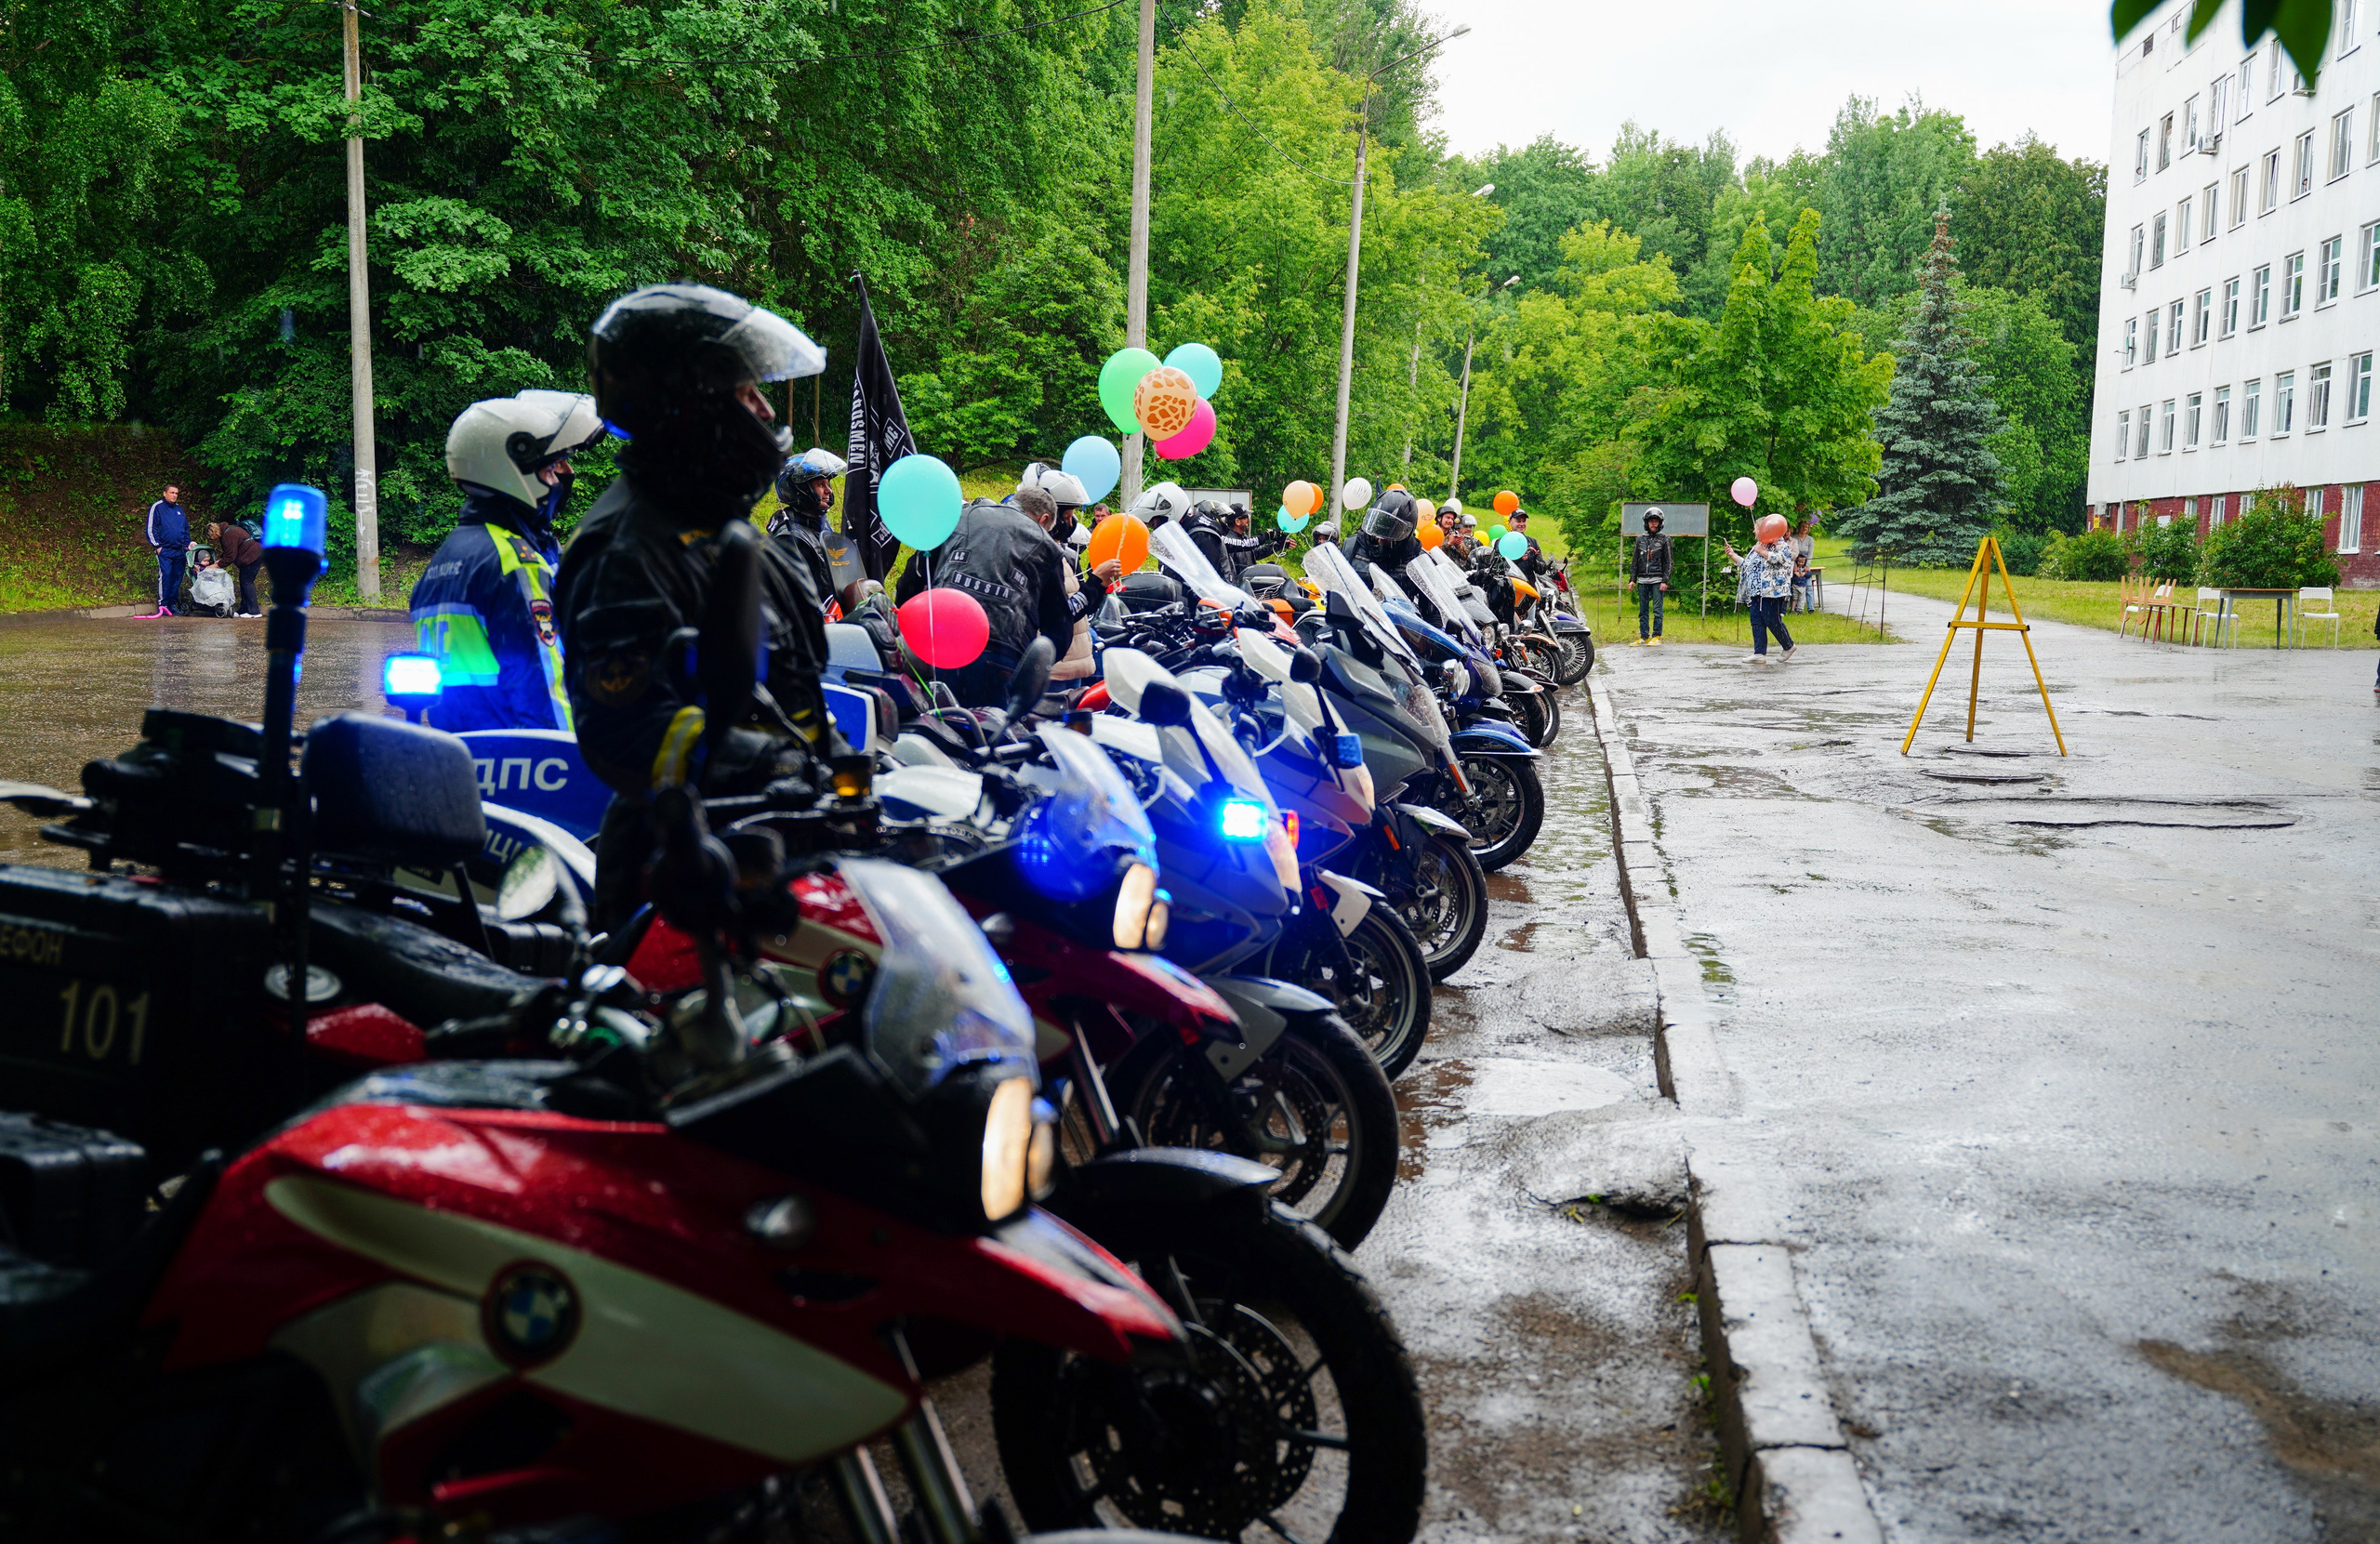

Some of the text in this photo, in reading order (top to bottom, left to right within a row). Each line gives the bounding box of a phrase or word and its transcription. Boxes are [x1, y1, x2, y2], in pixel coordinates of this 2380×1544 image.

[954, 574, 1010, 599] RUSSIA
[477, 758, 569, 796] ДПС
[59, 978, 151, 1066] 101
